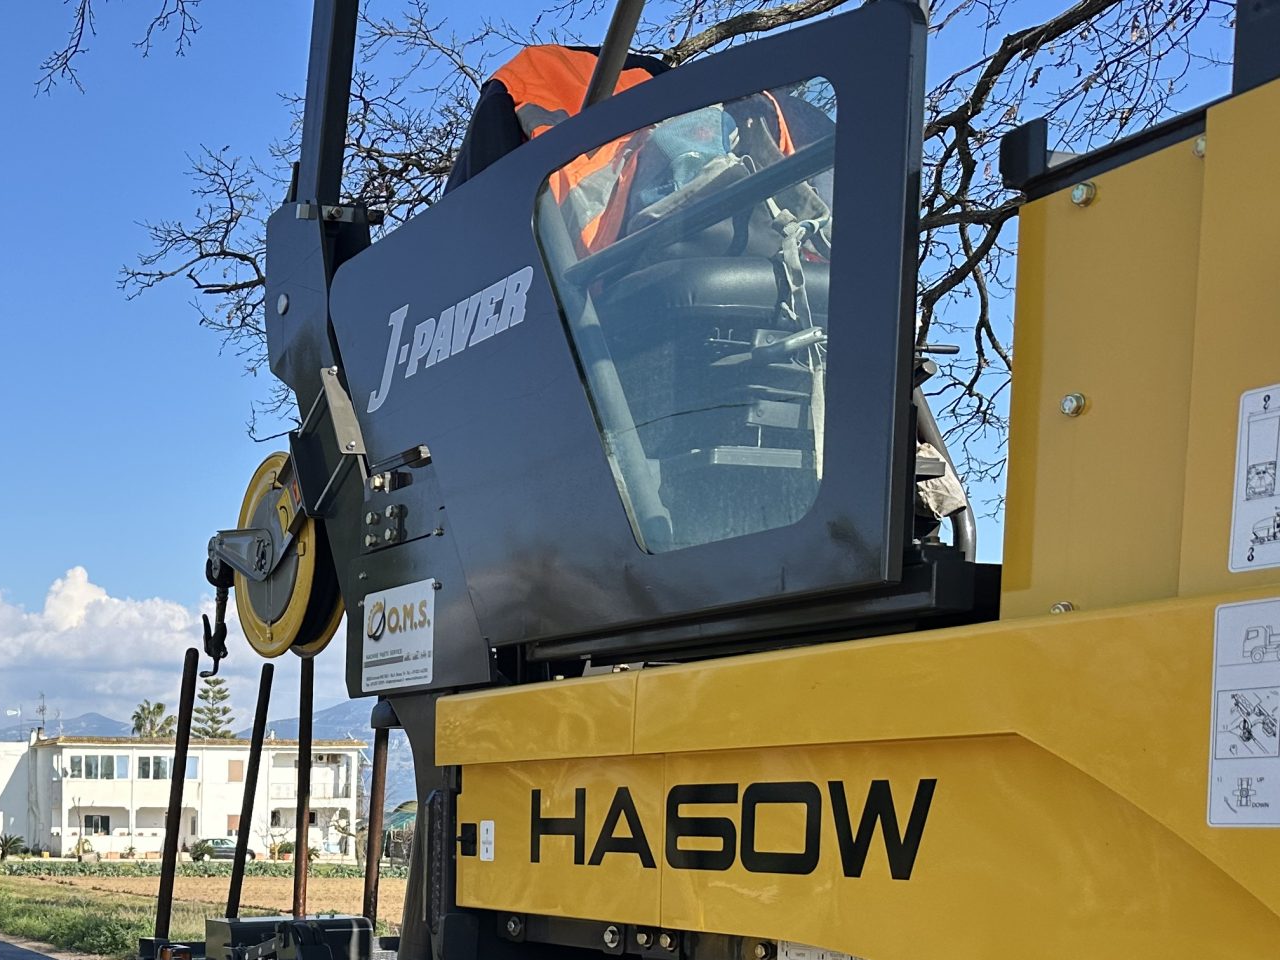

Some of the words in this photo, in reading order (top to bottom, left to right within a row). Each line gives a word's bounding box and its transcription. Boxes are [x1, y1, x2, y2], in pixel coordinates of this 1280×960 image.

[367, 265, 534, 413] J-PAVER
[387, 600, 431, 634] O.M.S.
[530, 778, 938, 881] HA60W
